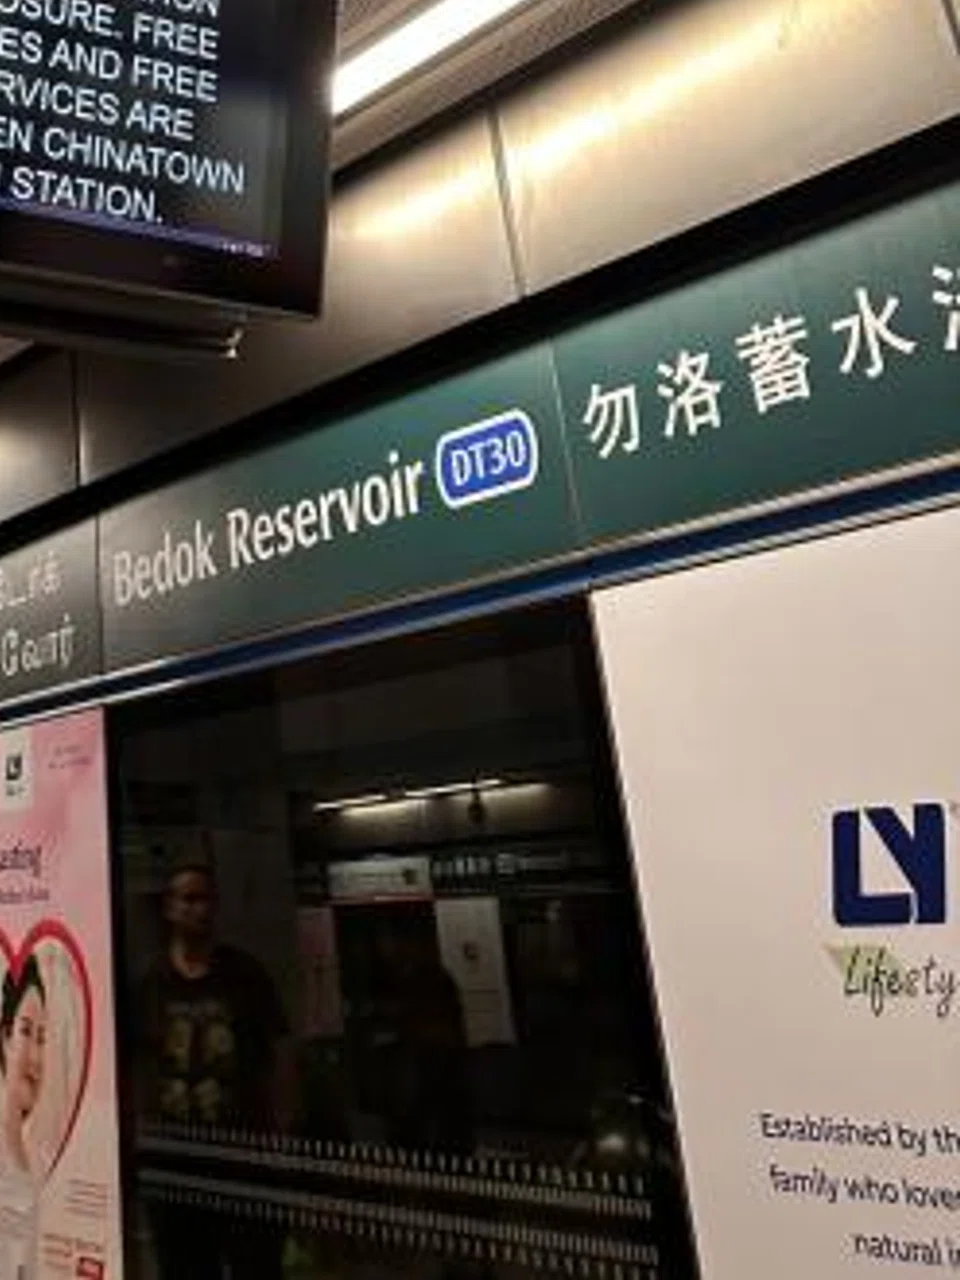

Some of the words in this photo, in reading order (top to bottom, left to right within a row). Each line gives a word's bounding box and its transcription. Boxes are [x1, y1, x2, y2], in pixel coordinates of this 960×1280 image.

[133, 13, 220, 60] FREE
[48, 38, 121, 81] AND
[132, 58, 218, 103] FREE
[126, 98, 194, 142] ARE
[42, 128, 245, 194] CHINATOWN
[11, 167, 164, 224] STATION.
[112, 520, 217, 606] Bedok
[226, 450, 426, 569] Reservoir
[451, 430, 528, 488] DT30
[832, 803, 946, 926] LY
[760, 1113, 891, 1147] Established
[897, 1123, 926, 1157] by
[770, 1164, 838, 1204] family
[843, 1175, 900, 1204] who
[855, 1233, 942, 1266] natural
